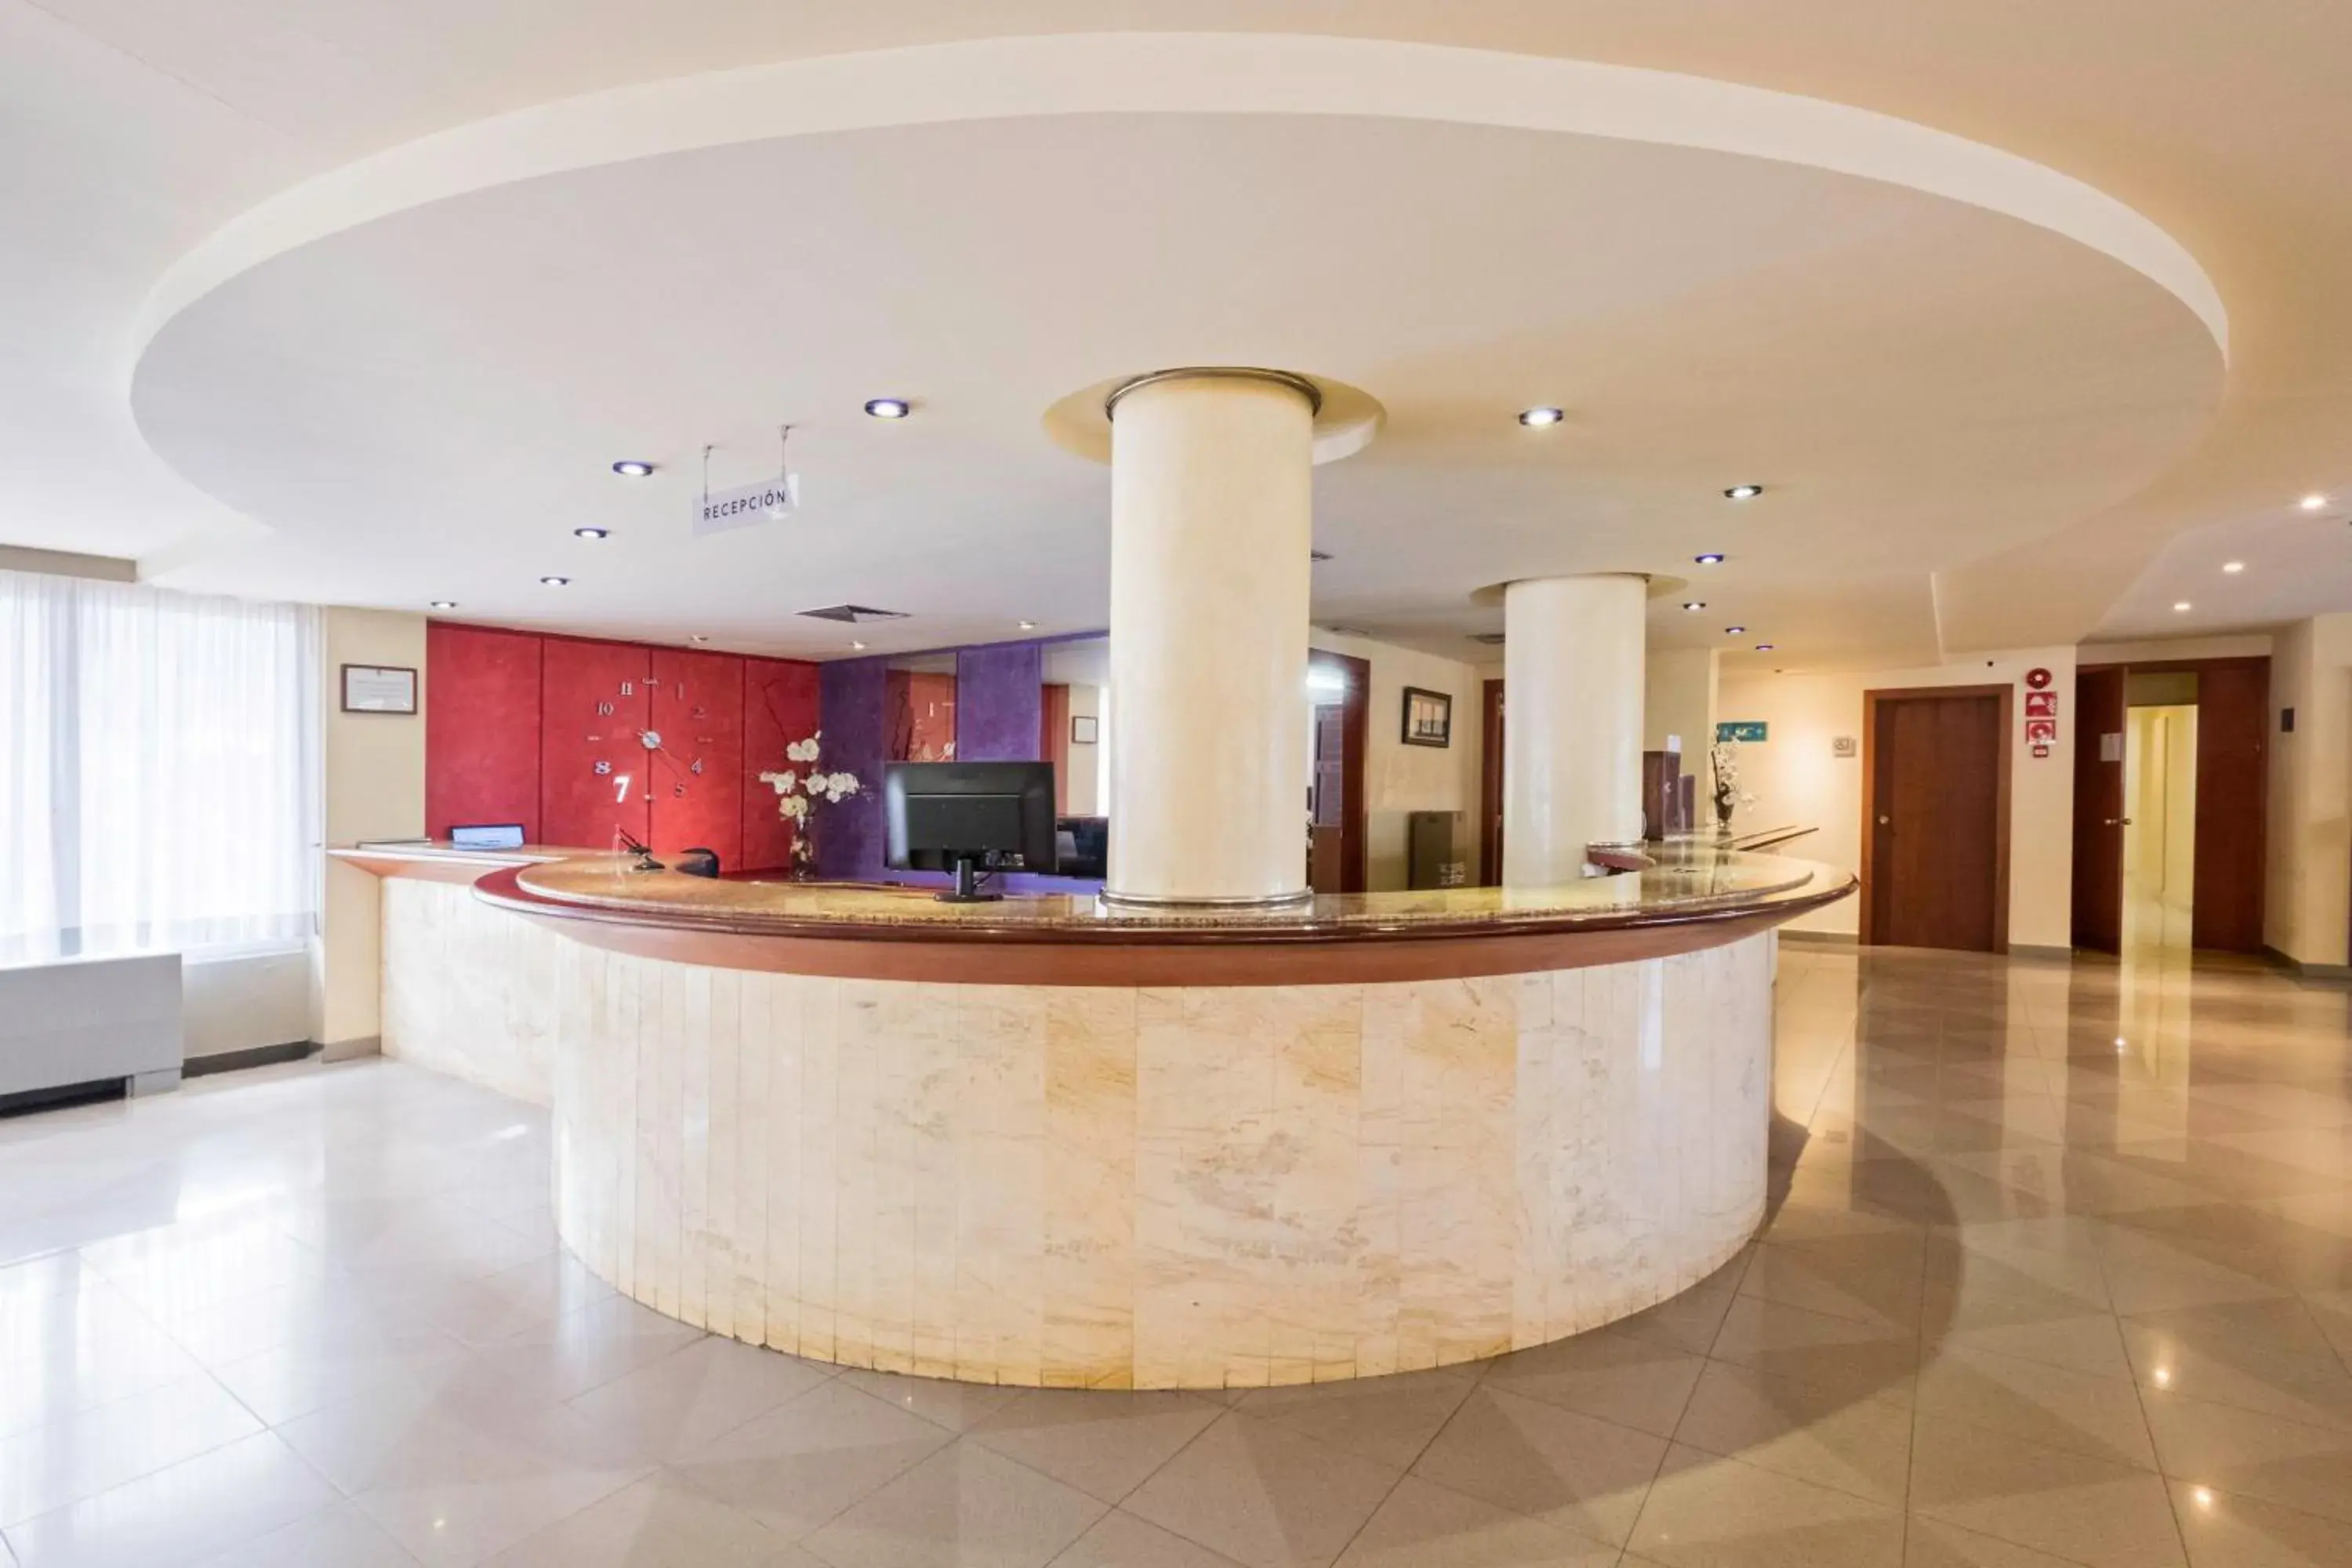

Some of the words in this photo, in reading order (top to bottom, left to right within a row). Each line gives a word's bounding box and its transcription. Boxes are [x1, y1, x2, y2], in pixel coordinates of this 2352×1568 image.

[703, 489, 786, 521] RECEPCIÓN
[595, 761, 612, 775] 8
[613, 776, 630, 803] 7
